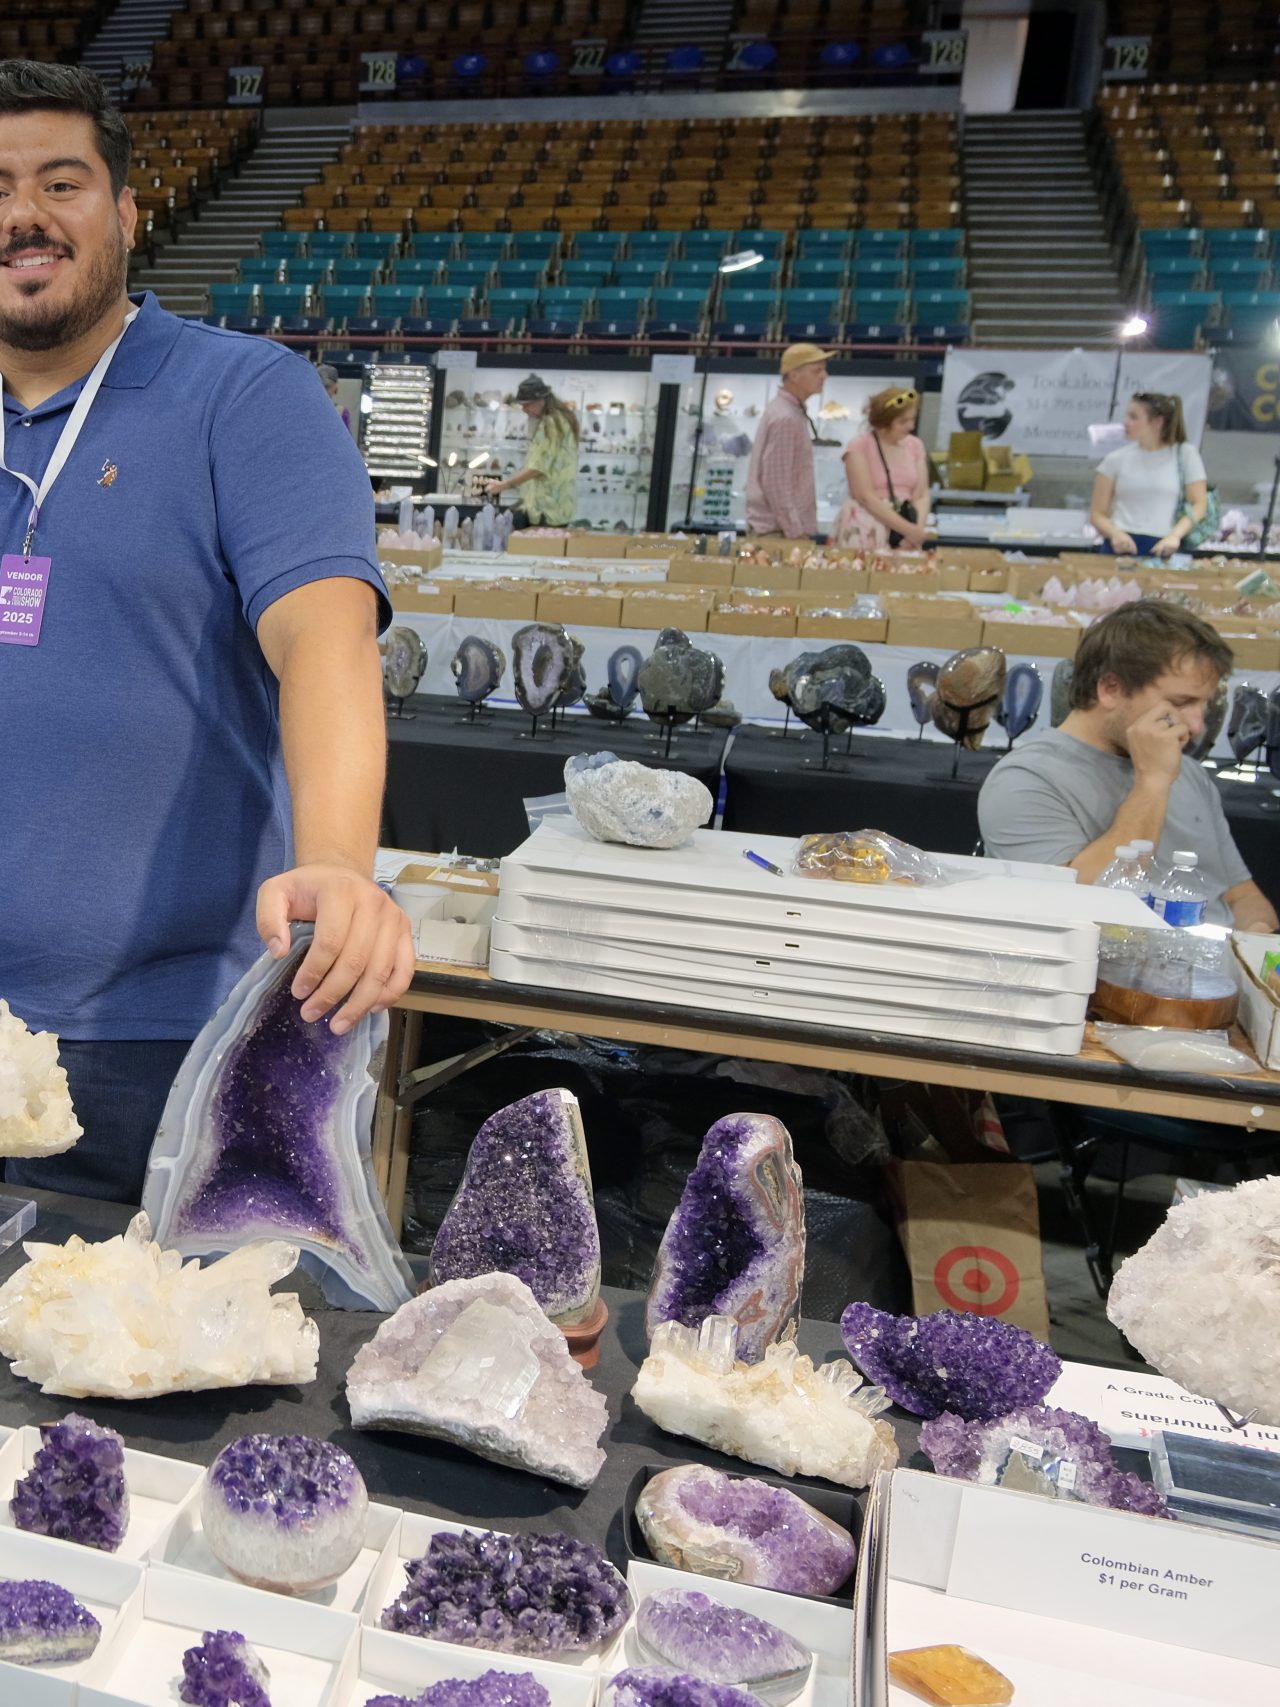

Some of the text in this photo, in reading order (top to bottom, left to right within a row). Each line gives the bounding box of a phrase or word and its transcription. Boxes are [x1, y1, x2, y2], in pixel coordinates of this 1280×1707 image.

[929, 39, 964, 66] 128
[1113, 44, 1149, 69] 129
[368, 59, 397, 84] 128
[234, 74, 262, 97] 127
[7, 571, 43, 581] VENDOR
[13, 587, 43, 598] COLORADO
[20, 596, 41, 607] SHOW
[2, 611, 33, 624] 2025
[1106, 1383, 1119, 1392] A
[1123, 1386, 1175, 1401] Grade
[1120, 1409, 1248, 1438] Lemurians
[1080, 1552, 1214, 1588] Colombian Amber
[1098, 1572, 1188, 1600] $1 per Gram
